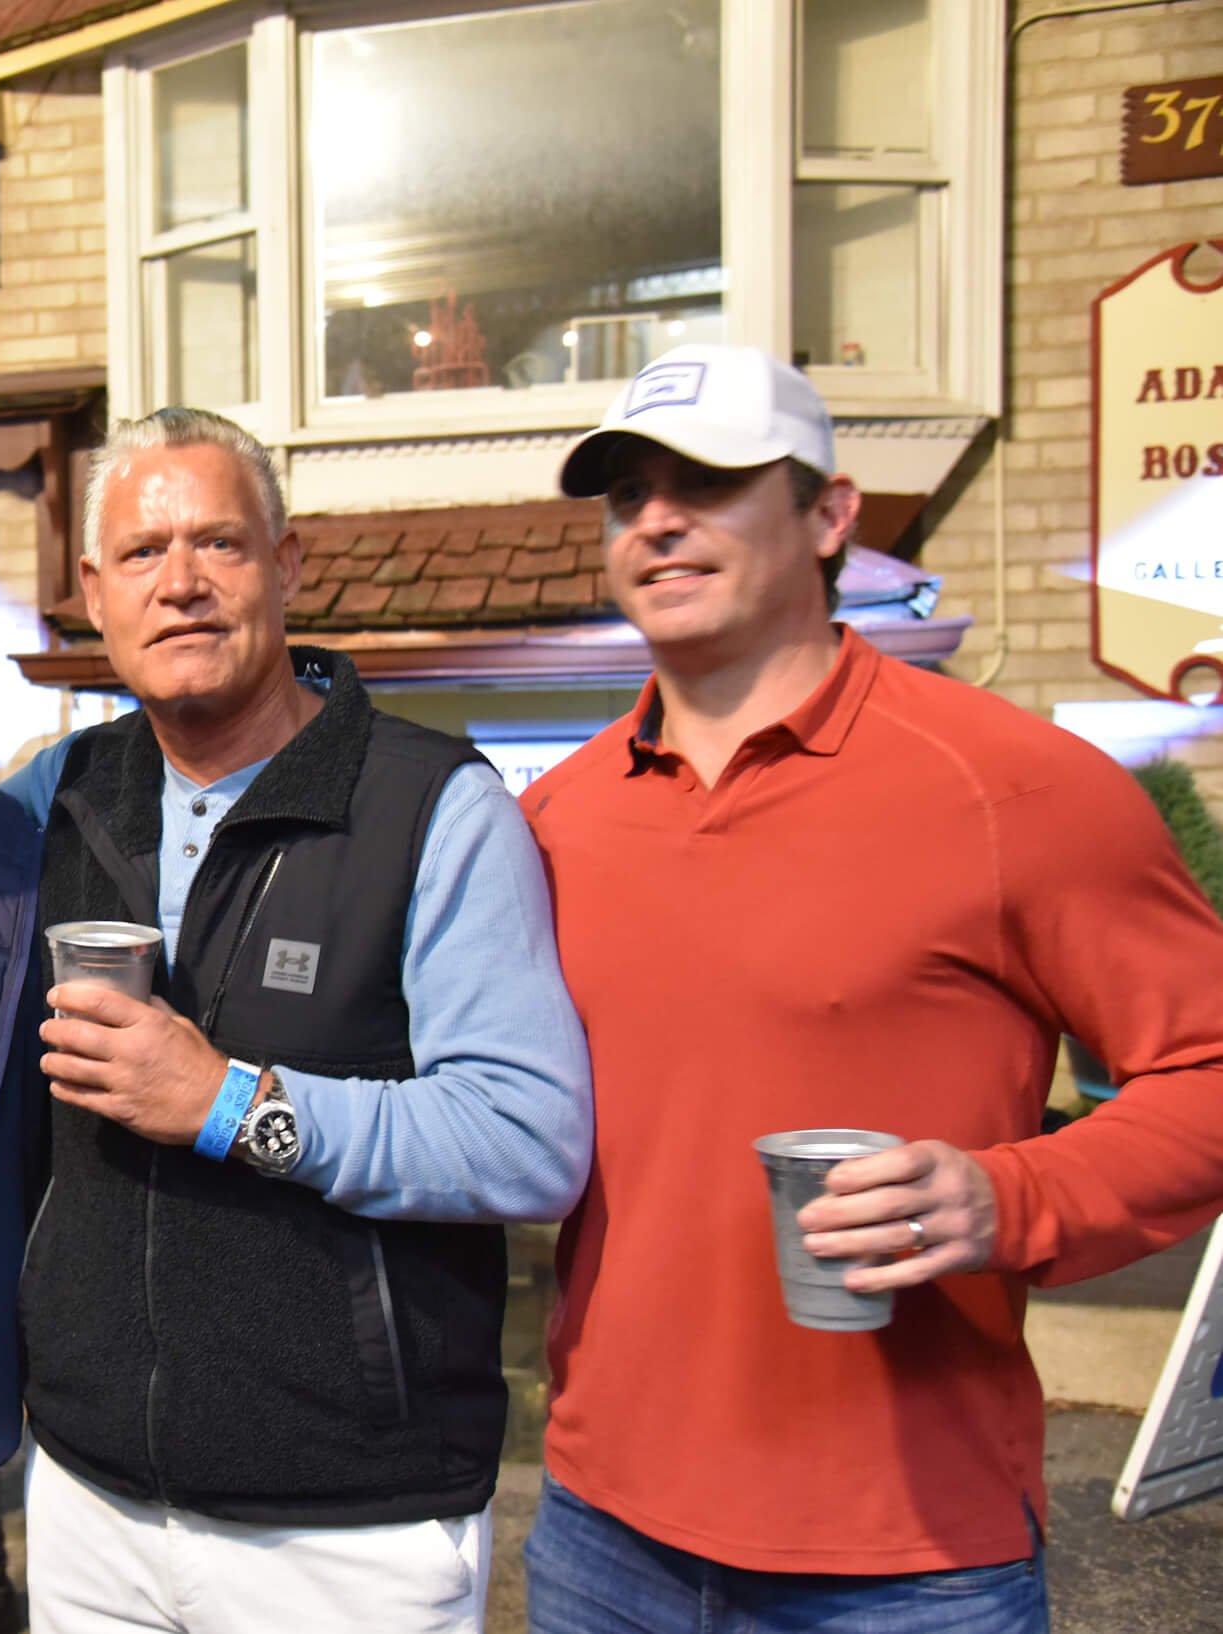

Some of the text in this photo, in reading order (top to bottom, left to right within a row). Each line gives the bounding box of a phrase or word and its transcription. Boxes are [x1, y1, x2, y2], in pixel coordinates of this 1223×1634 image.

[1140, 89, 1223, 157] 37
[1134, 364, 1223, 403] ADA
[1140, 443, 1223, 480] ROS
